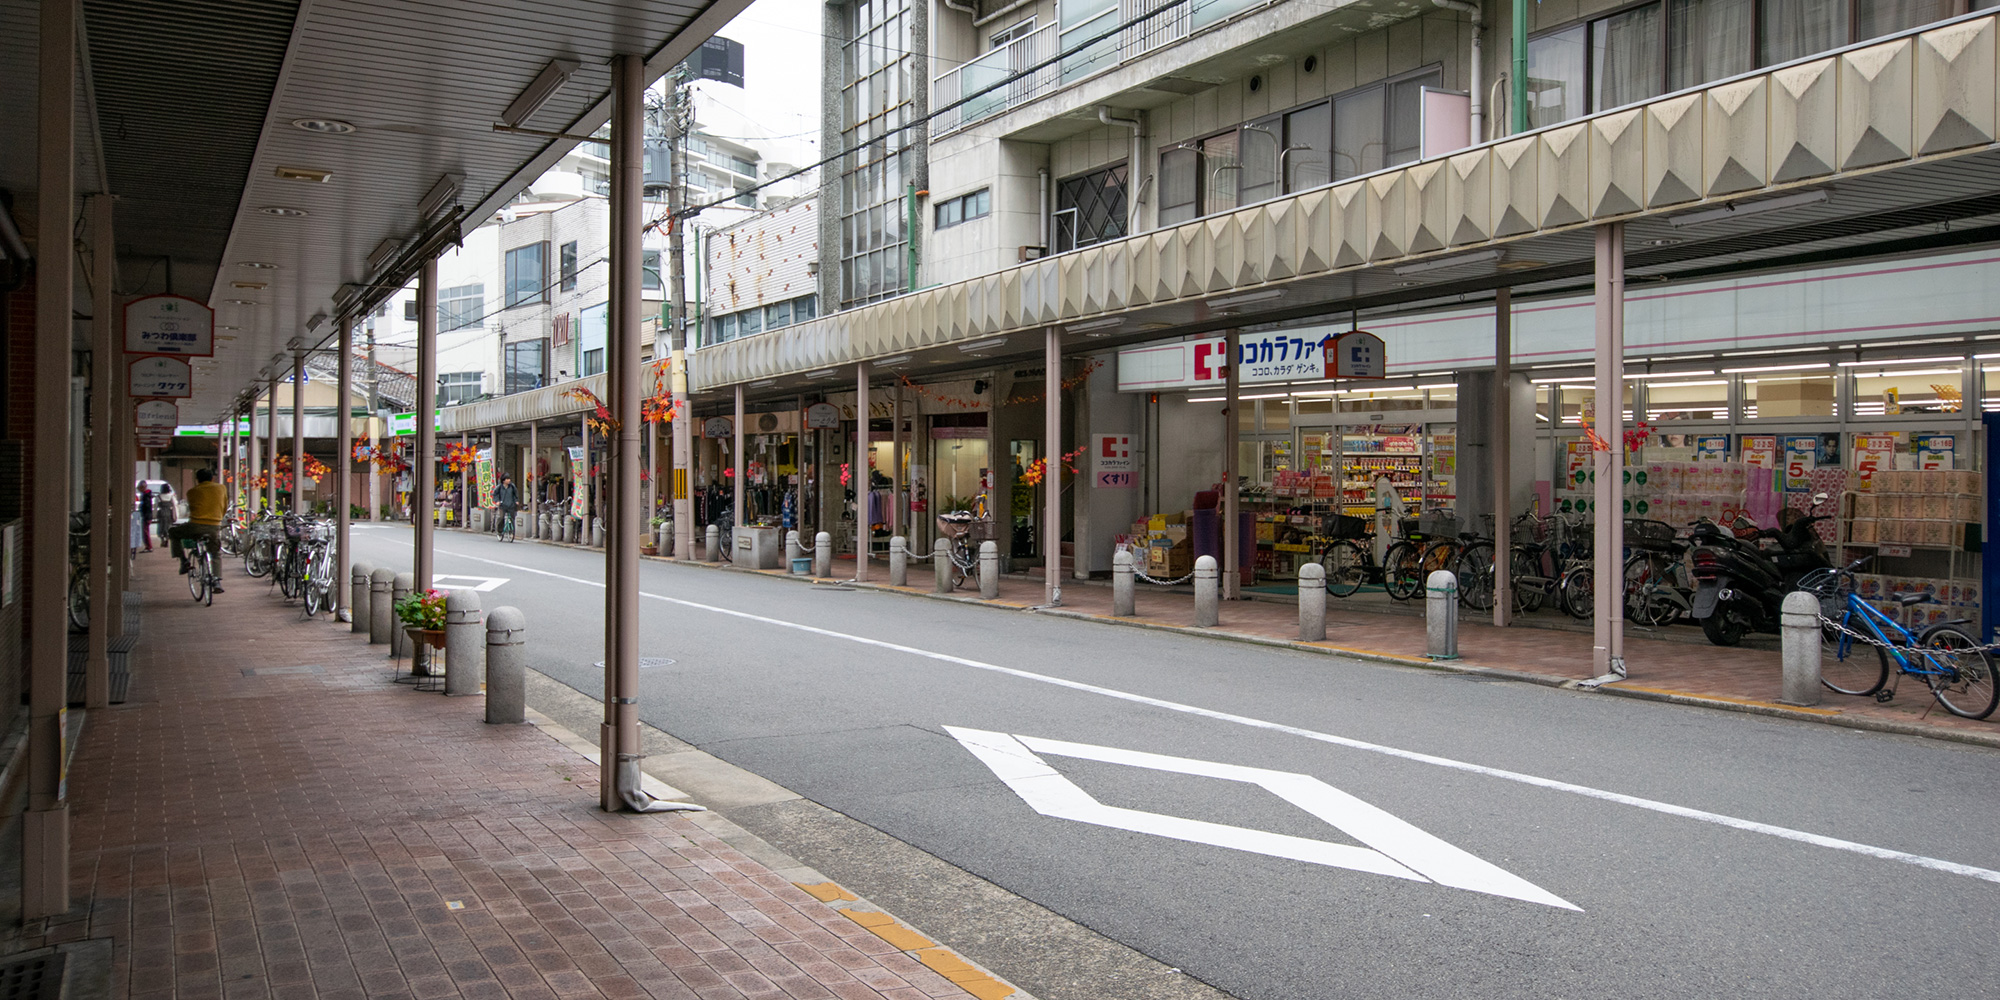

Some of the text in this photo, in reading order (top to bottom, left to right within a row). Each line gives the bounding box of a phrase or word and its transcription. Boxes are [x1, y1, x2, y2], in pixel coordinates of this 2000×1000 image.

[1252, 363, 1319, 377] ココロ、カラダ ゲンキ。
[1102, 474, 1129, 485] くすり
